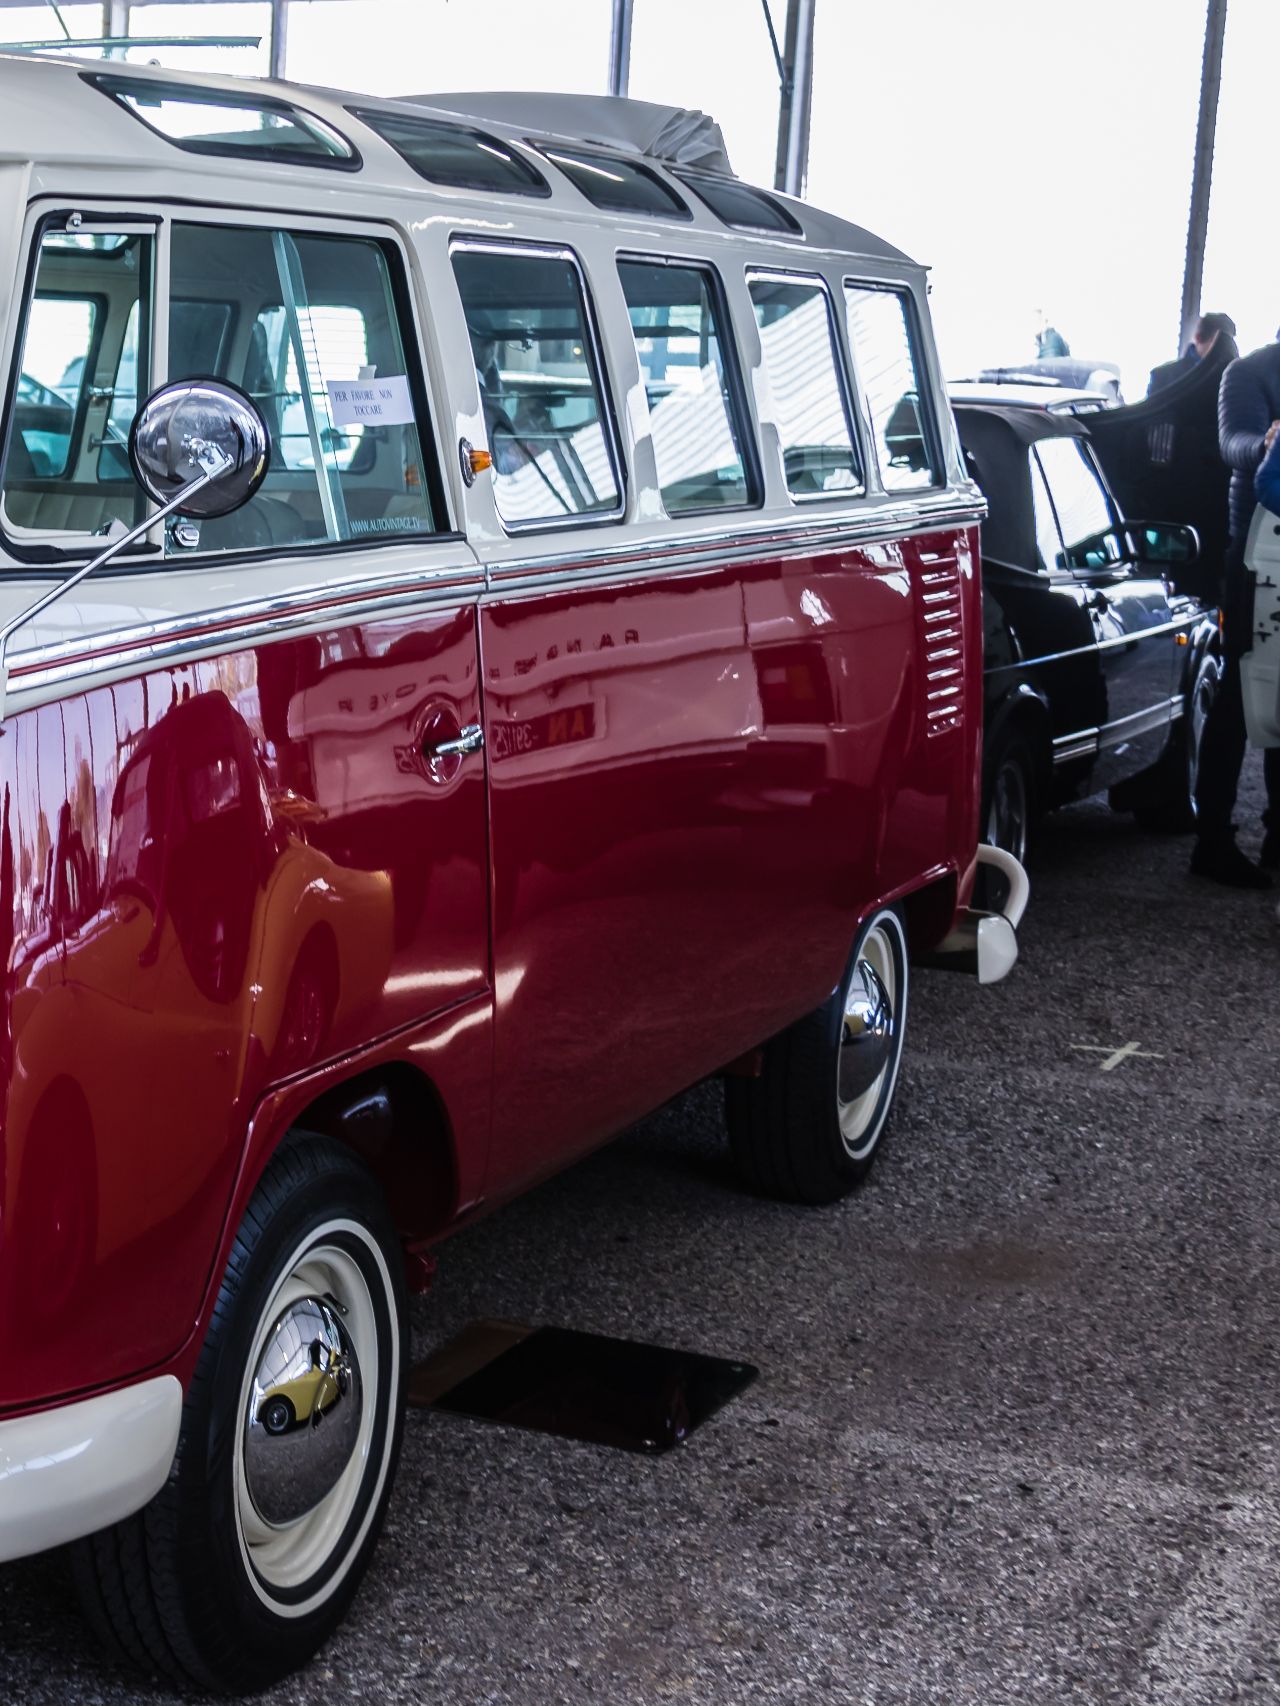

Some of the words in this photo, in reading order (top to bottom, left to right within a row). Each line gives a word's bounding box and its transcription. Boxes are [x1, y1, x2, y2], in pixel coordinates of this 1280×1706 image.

[333, 389, 348, 402] PER
[351, 390, 375, 402] FAVORE
[379, 389, 393, 400] NON
[353, 404, 383, 417] TOCCARE
